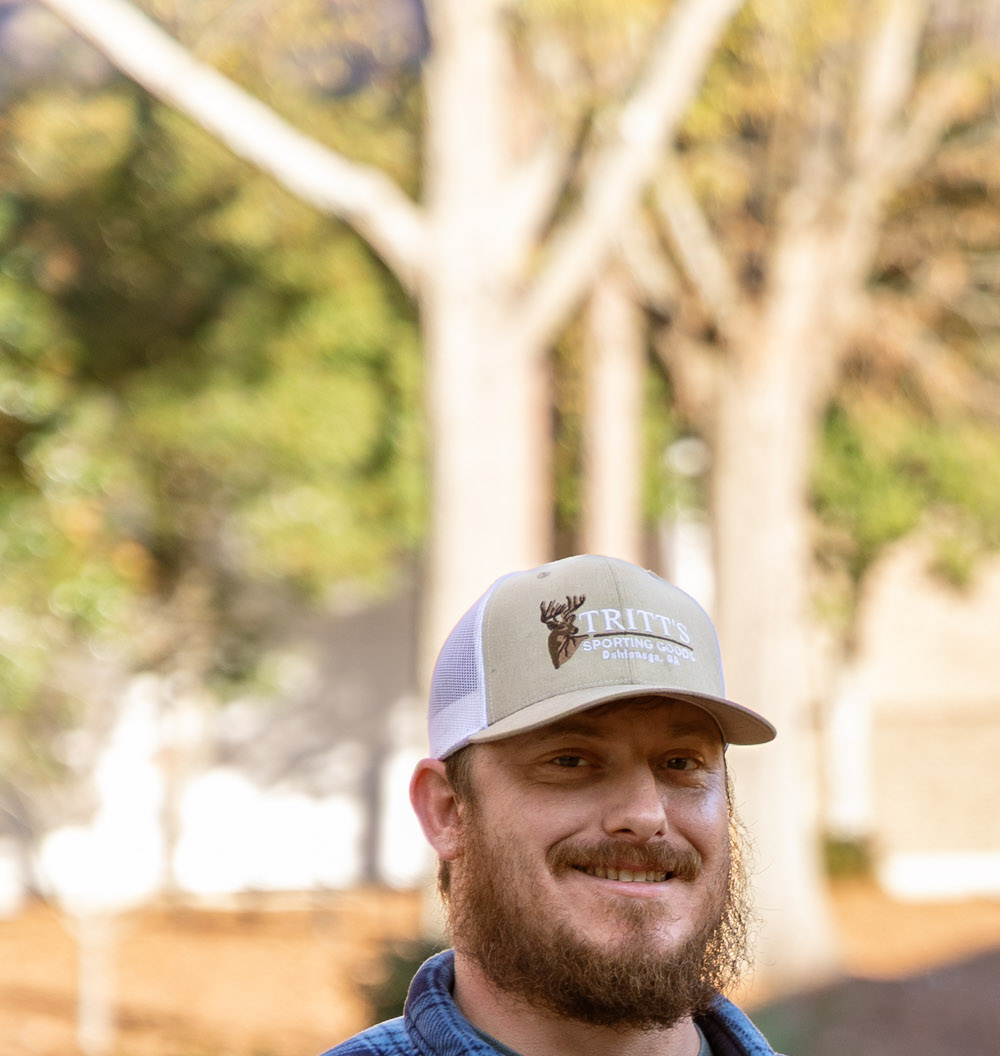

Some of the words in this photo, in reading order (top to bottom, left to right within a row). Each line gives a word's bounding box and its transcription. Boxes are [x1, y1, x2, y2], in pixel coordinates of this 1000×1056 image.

[579, 608, 691, 643] TRITT'S
[582, 637, 654, 651] SPORTING
[656, 641, 696, 662] GOODS
